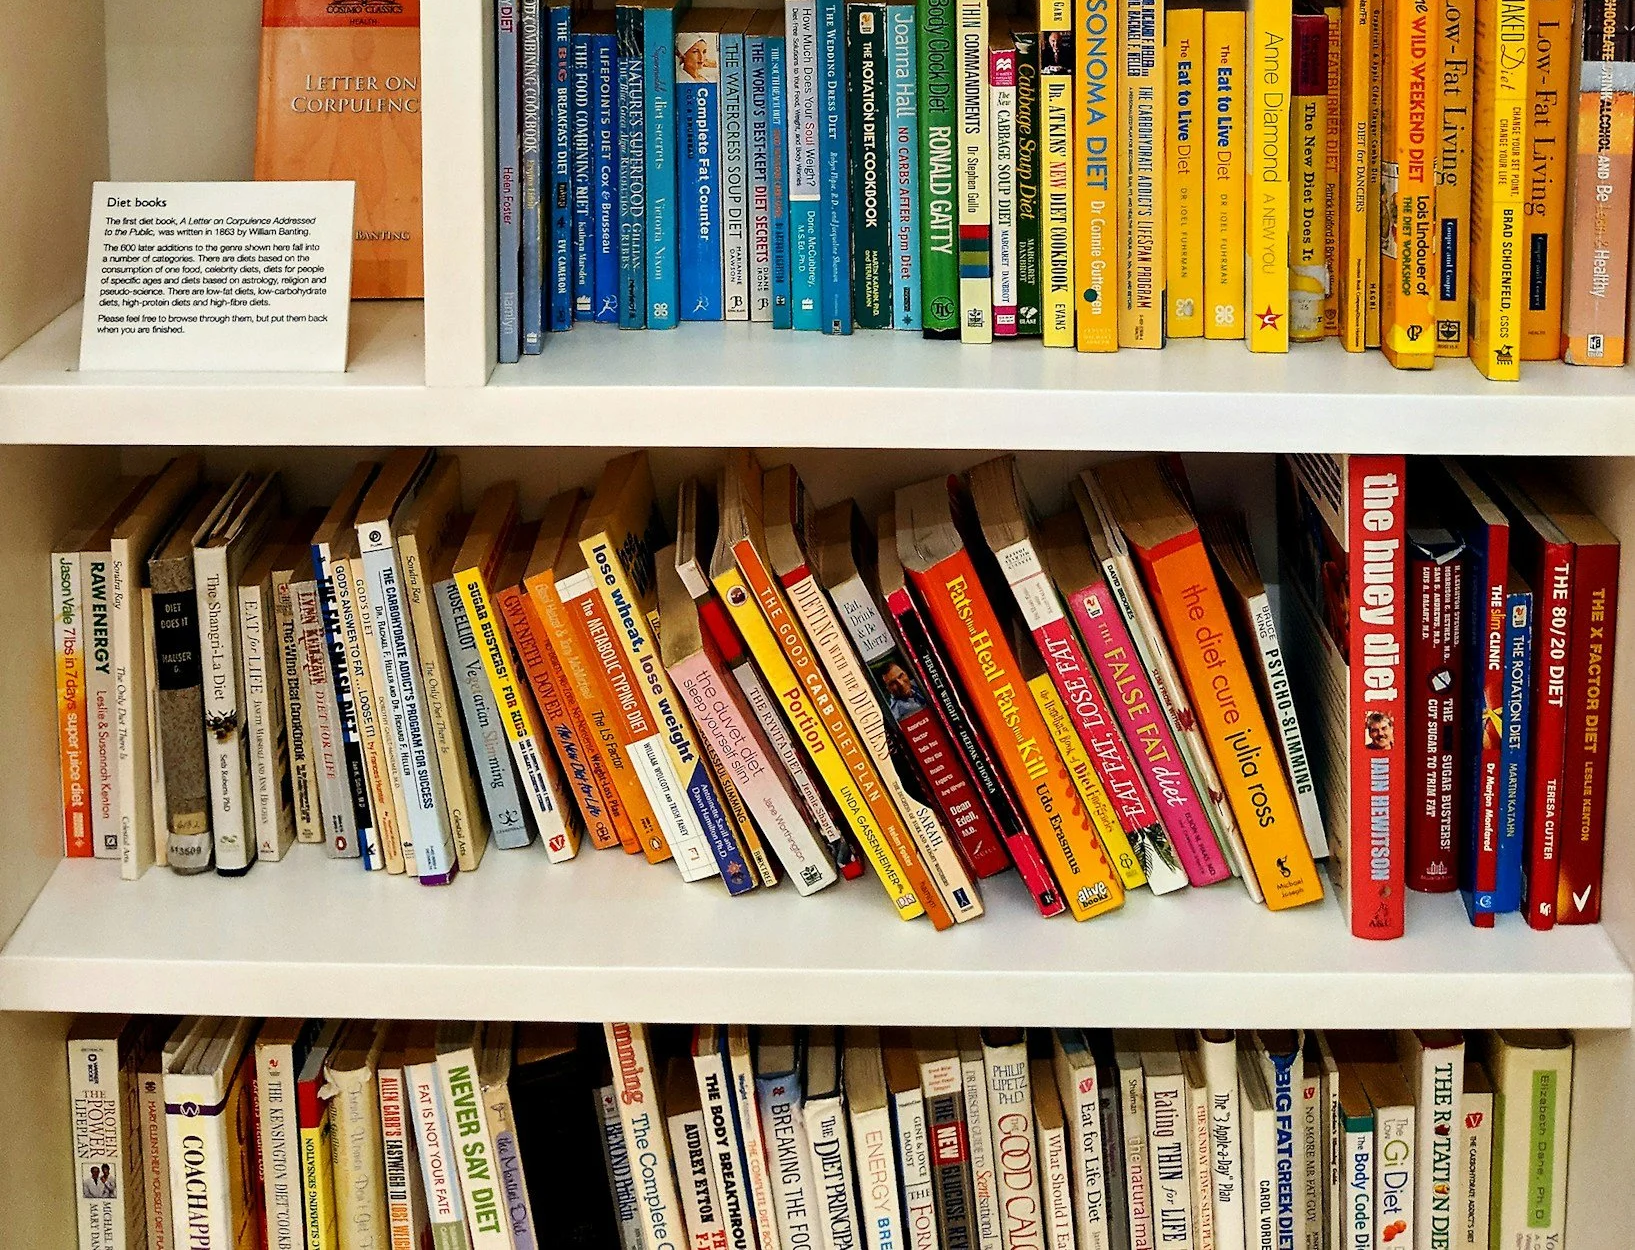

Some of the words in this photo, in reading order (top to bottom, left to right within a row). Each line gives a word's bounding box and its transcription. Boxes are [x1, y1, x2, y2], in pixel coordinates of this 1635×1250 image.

[963, 2, 980, 28] THIN
[1411, 16, 1426, 58] WILD
[1086, 0, 1108, 126] SONOMA
[1265, 31, 1284, 86] Anne
[306, 75, 379, 91] LETTER
[385, 76, 417, 90] ON
[964, 33, 981, 134] COMMANDMENTS
[1410, 63, 1425, 144] WEEKEND
[697, 88, 709, 154] Complete
[1263, 93, 1282, 182] Diamond
[698, 158, 710, 182] Fat
[929, 126, 951, 199] RONALD
[1087, 137, 1108, 190] DIET
[1408, 149, 1424, 183] DIET
[105, 217, 120, 225] The
[122, 217, 137, 225] first
[139, 217, 153, 225] diet
[155, 217, 178, 227] book,
[180, 217, 186, 225] A
[188, 217, 212, 225] Letter
[225, 217, 271, 227] Corpulence
[272, 217, 316, 225] Addressed
[107, 197, 131, 207] Diet
[135, 197, 167, 207] books
[698, 185, 710, 241] Counter
[104, 228, 113, 236] to
[114, 228, 127, 236] the
[129, 228, 155, 238] Public,
[176, 228, 203, 236] written
[205, 228, 213, 236] in
[216, 228, 235, 236] 1863
[237, 228, 247, 238] by
[249, 228, 277, 236] William
[279, 228, 311, 238] Banting.
[355, 230, 410, 240] BANTING
[929, 203, 951, 254] GATTY
[97, 326, 118, 334] when
[152, 326, 185, 334] finished.
[98, 314, 124, 322] Please
[126, 314, 140, 322] feel
[141, 314, 156, 322] free
[158, 314, 166, 322] to
[168, 314, 197, 322] browse
[199, 314, 230, 324] through
[231, 314, 254, 324] them,
[256, 314, 269, 322] but
[271, 314, 284, 324] put
[286, 314, 306, 322] them
[308, 314, 328, 322] back
[1363, 473, 1400, 532] the
[90, 562, 106, 600] RAW
[206, 574, 219, 598] The
[1181, 583, 1209, 622] the
[1360, 537, 1400, 624] huey
[1553, 564, 1569, 600] THE
[93, 604, 110, 675] ENERGY
[208, 602, 224, 670] Shangri-La
[592, 543, 616, 586] lose
[612, 588, 645, 653] wheat,
[640, 655, 663, 695] lose
[658, 697, 695, 763] weight
[1195, 626, 1225, 669] diet
[1550, 606, 1568, 661] 80/20
[213, 674, 225, 701] Diet
[1362, 632, 1400, 703] diet
[1547, 664, 1564, 708] DIET
[783, 688, 826, 755] Portion
[1103, 646, 1149, 721] FALSE
[1135, 723, 1170, 763] FAT
[1212, 674, 1240, 725] cure
[1265, 649, 1311, 795] PSYCHO-SLIMMING
[1224, 728, 1261, 779] julia
[1248, 783, 1276, 829] ross
[448, 1065, 481, 1137] NEVER
[1081, 1101, 1095, 1127] Eat
[1153, 1090, 1178, 1138] Eating
[463, 1141, 491, 1182] SAY
[771, 1102, 800, 1184] BREAKING
[1083, 1131, 1098, 1154] for
[1158, 1142, 1183, 1181] THIN
[1085, 1156, 1100, 1187] Life
[472, 1187, 501, 1234] DIET
[1087, 1191, 1102, 1224] Diet
[1162, 1185, 1176, 1206] for
[1161, 1207, 1187, 1242] LIFE
